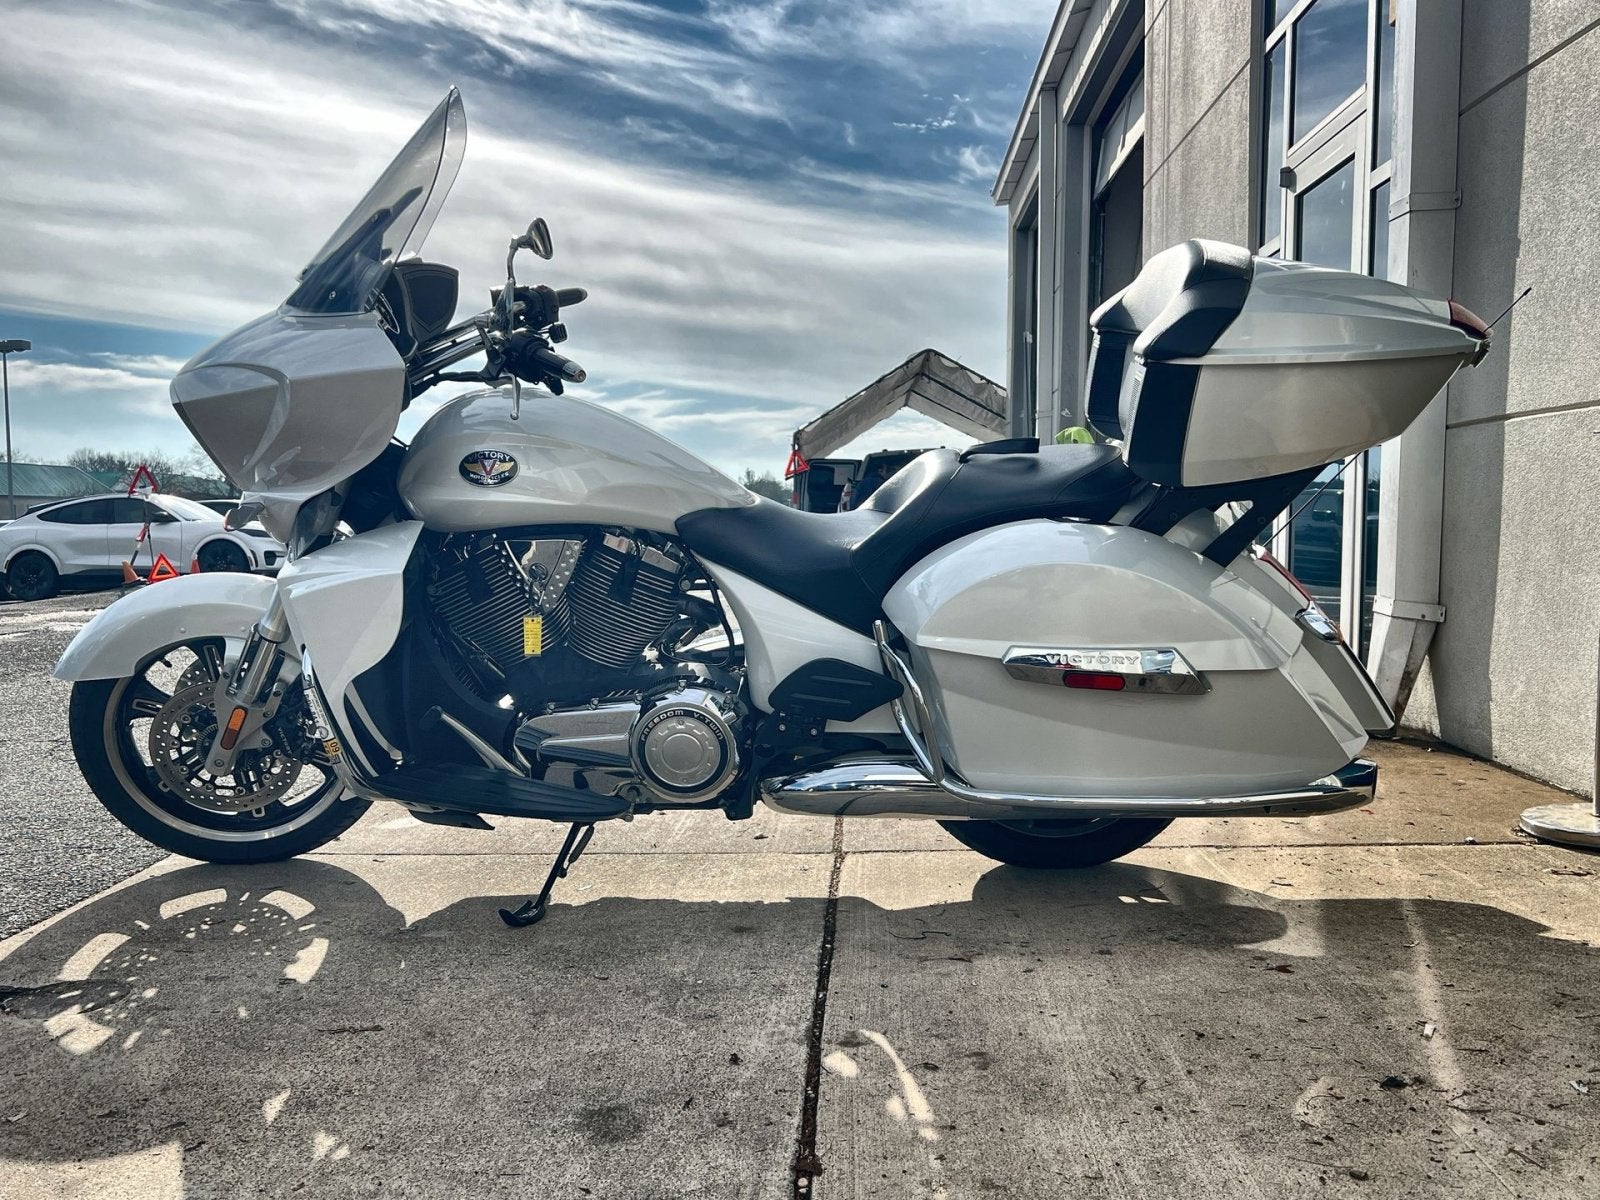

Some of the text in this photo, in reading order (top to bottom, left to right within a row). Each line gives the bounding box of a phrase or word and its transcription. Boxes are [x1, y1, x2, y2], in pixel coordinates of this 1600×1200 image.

[467, 451, 510, 462] VICTORY
[470, 472, 509, 481] MOTOYCLES
[1045, 653, 1140, 665] VICTORY
